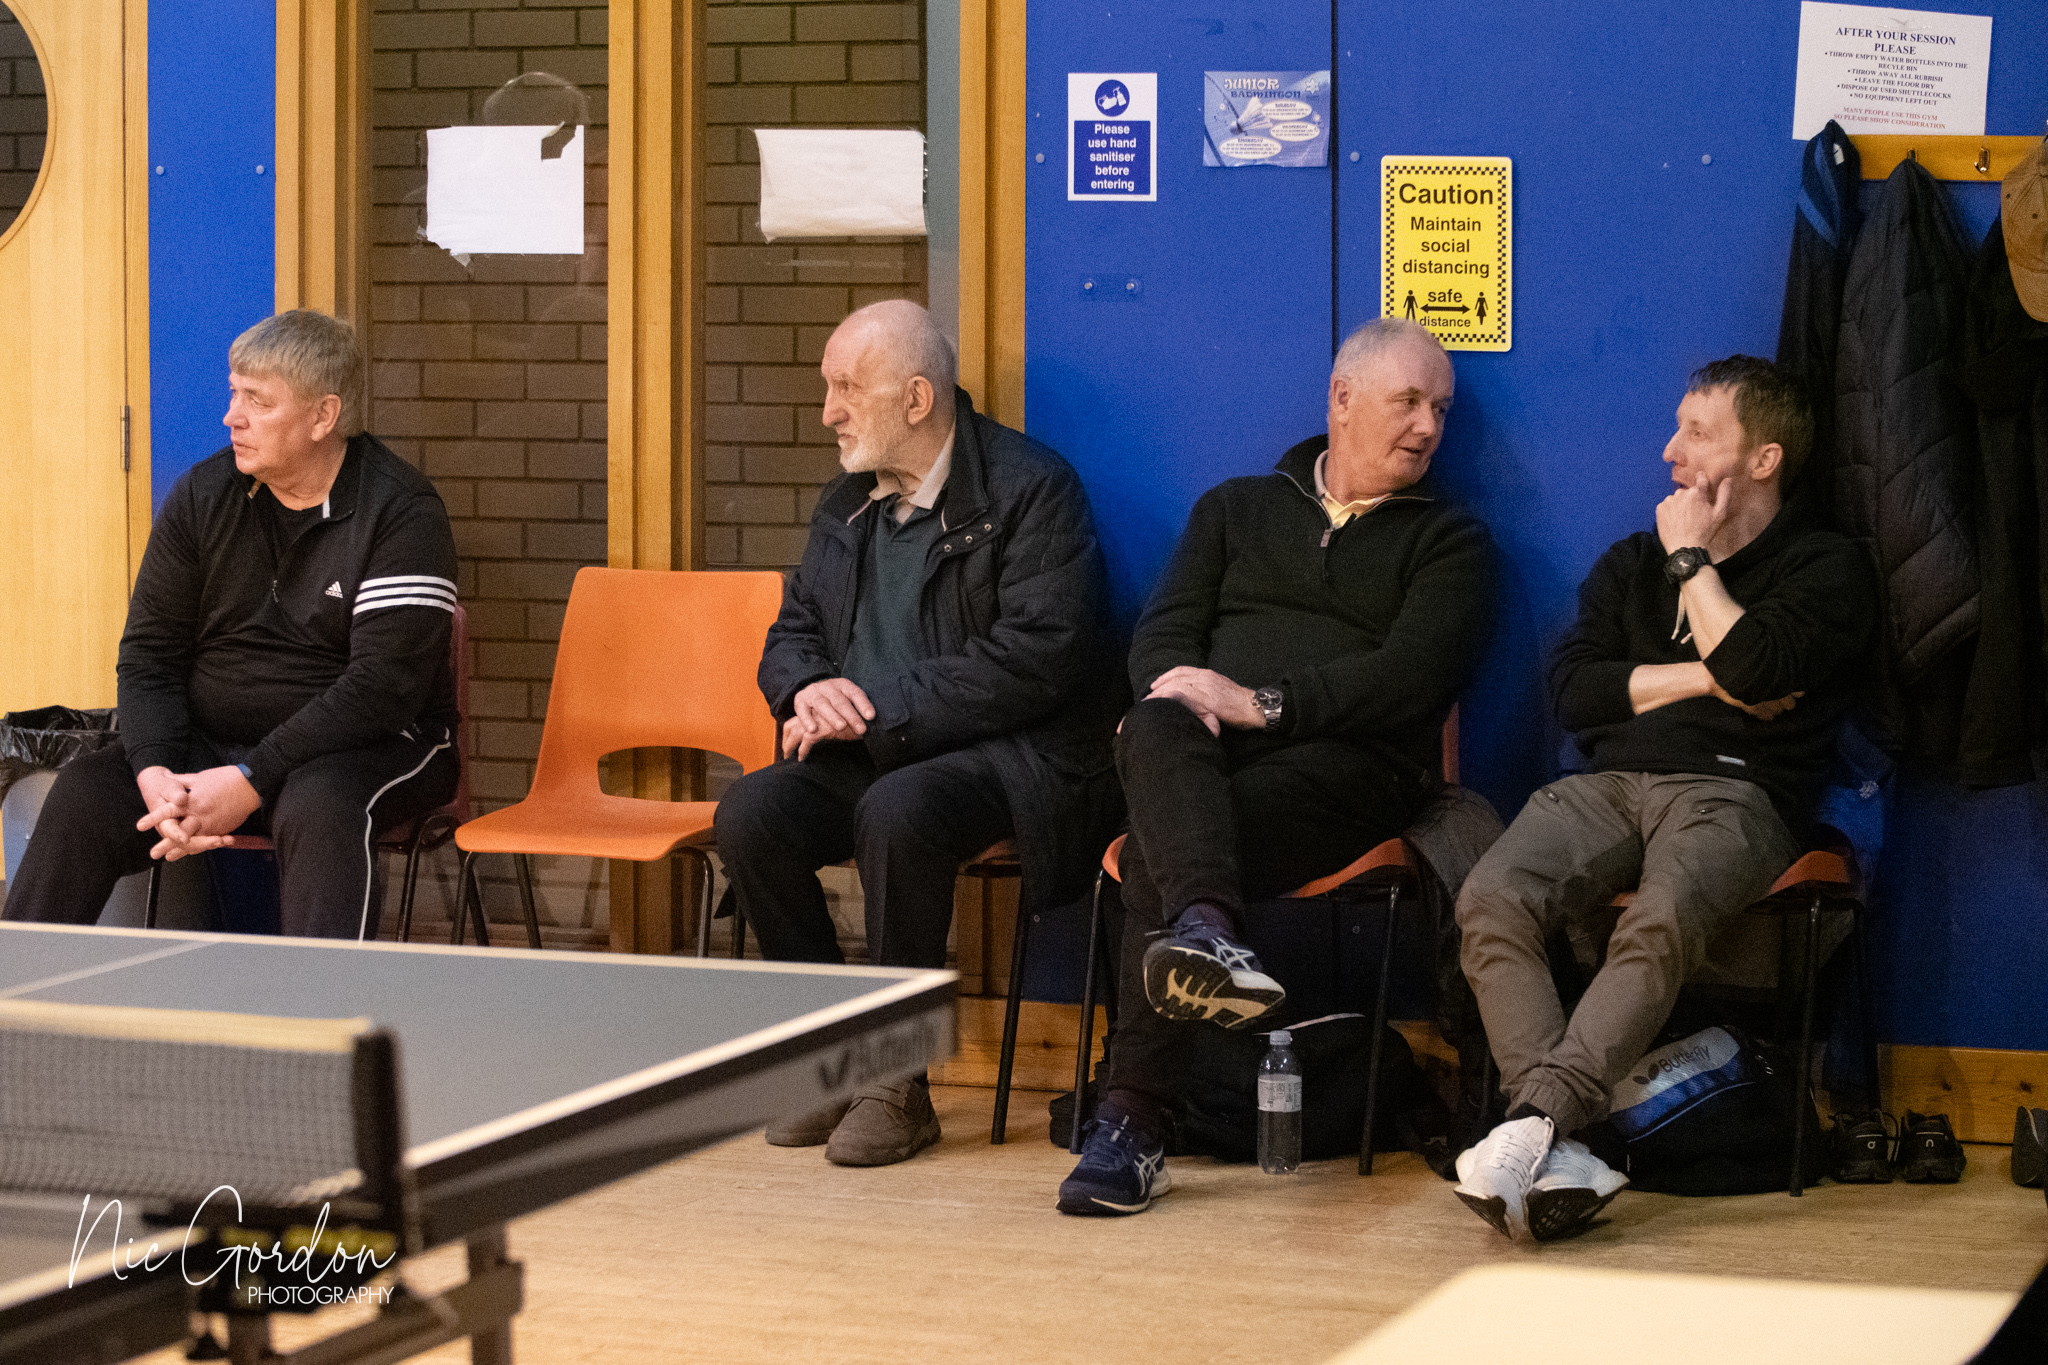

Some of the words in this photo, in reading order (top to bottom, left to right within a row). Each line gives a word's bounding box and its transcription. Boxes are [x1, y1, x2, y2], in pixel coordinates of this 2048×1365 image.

[1835, 27, 1872, 38] AFTER
[1876, 30, 1907, 41] YOUR
[1910, 33, 1956, 45] SESSION
[1874, 43, 1916, 55] PLEASE
[1880, 55, 1904, 63] WATER
[1905, 58, 1935, 66] BOTTLES
[1224, 78, 1279, 90] JUNIOR
[1865, 94, 1904, 102] EQUIPMENT
[1899, 89, 1951, 98] SHUTTLECOCKS
[1094, 123, 1130, 134] Please
[1891, 119, 1946, 129] CONSIDERATION
[1088, 139, 1107, 148] use
[1110, 137, 1136, 148] hand
[1089, 151, 1135, 162] sanitiser
[1095, 165, 1130, 175] before
[1090, 179, 1135, 192] entering
[1399, 183, 1494, 205] Caution
[1410, 216, 1481, 231] Maintain
[1421, 239, 1470, 252] social
[1402, 259, 1490, 278] distancing
[1427, 289, 1463, 303] safe
[1419, 316, 1471, 327] distance
[1659, 1045, 1711, 1073] Butterfly
